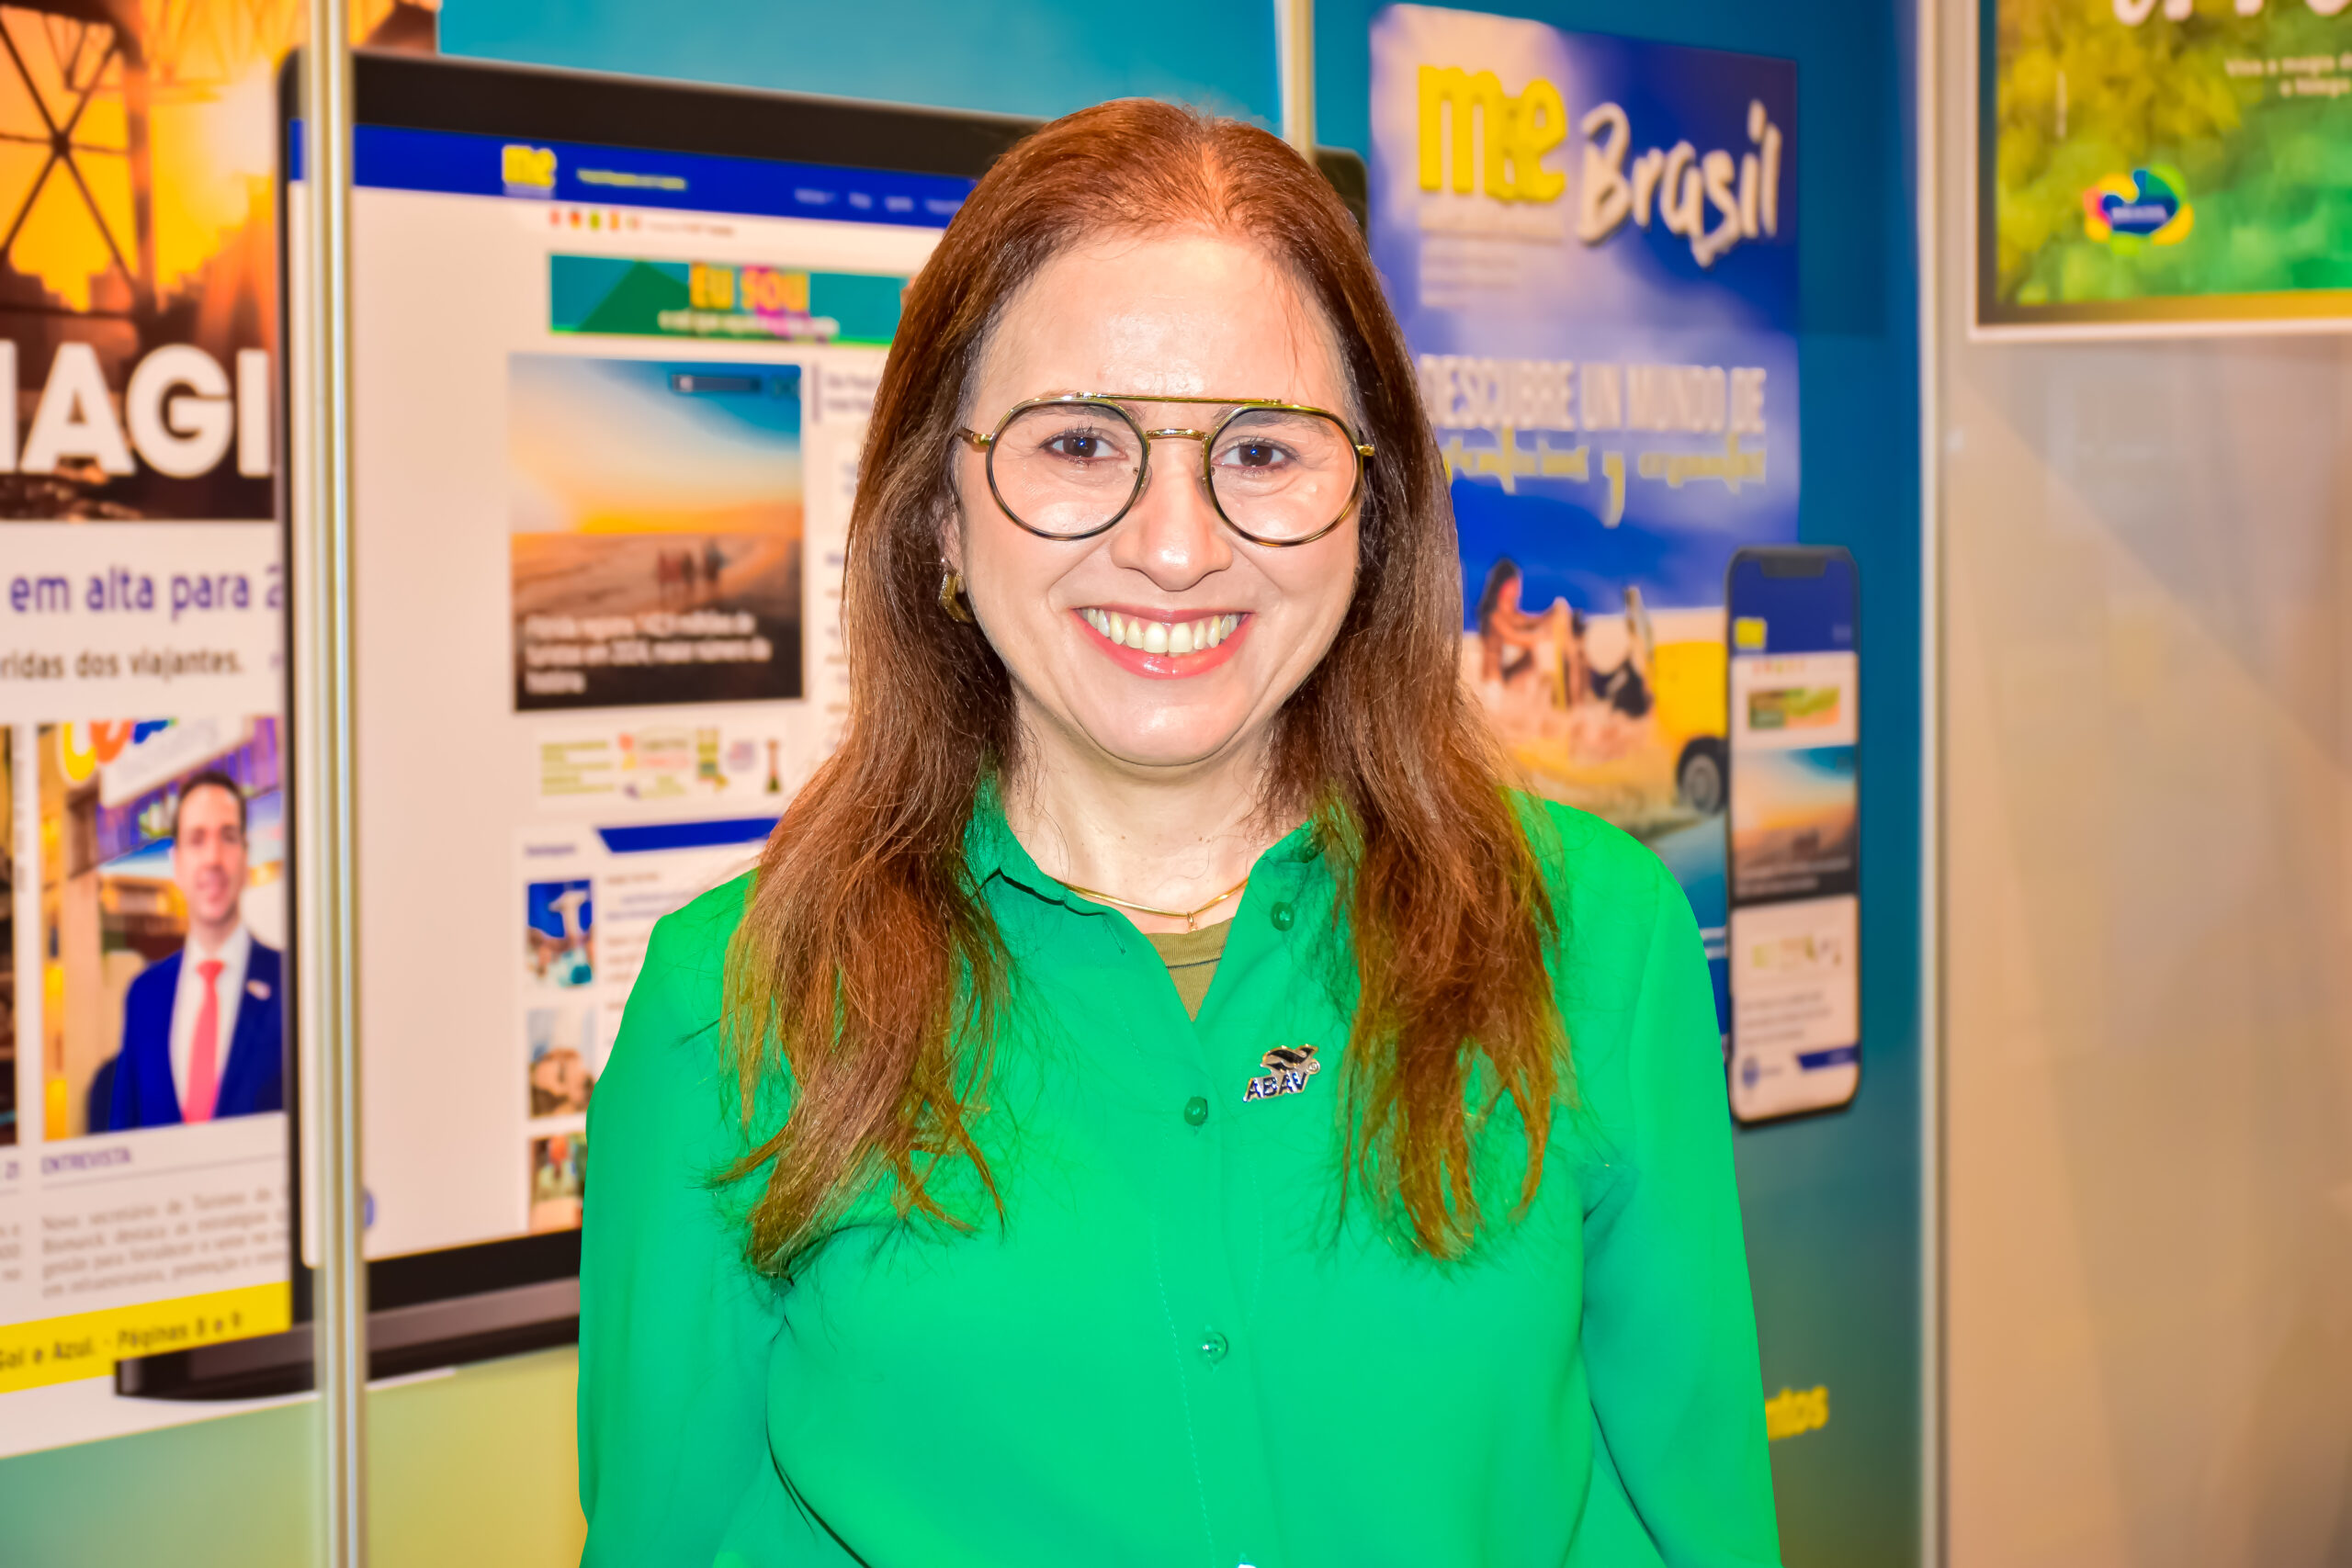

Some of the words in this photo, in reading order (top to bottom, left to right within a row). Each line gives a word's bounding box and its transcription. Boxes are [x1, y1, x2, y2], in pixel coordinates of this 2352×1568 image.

[1577, 98, 1783, 269] Brasil
[0, 340, 270, 479] AGI
[10, 575, 71, 612] em
[85, 566, 156, 610] alta
[170, 574, 251, 622] para
[75, 649, 119, 678] dos
[1244, 1069, 1309, 1101] ABAV
[41, 1147, 131, 1175] ENTREVISTA
